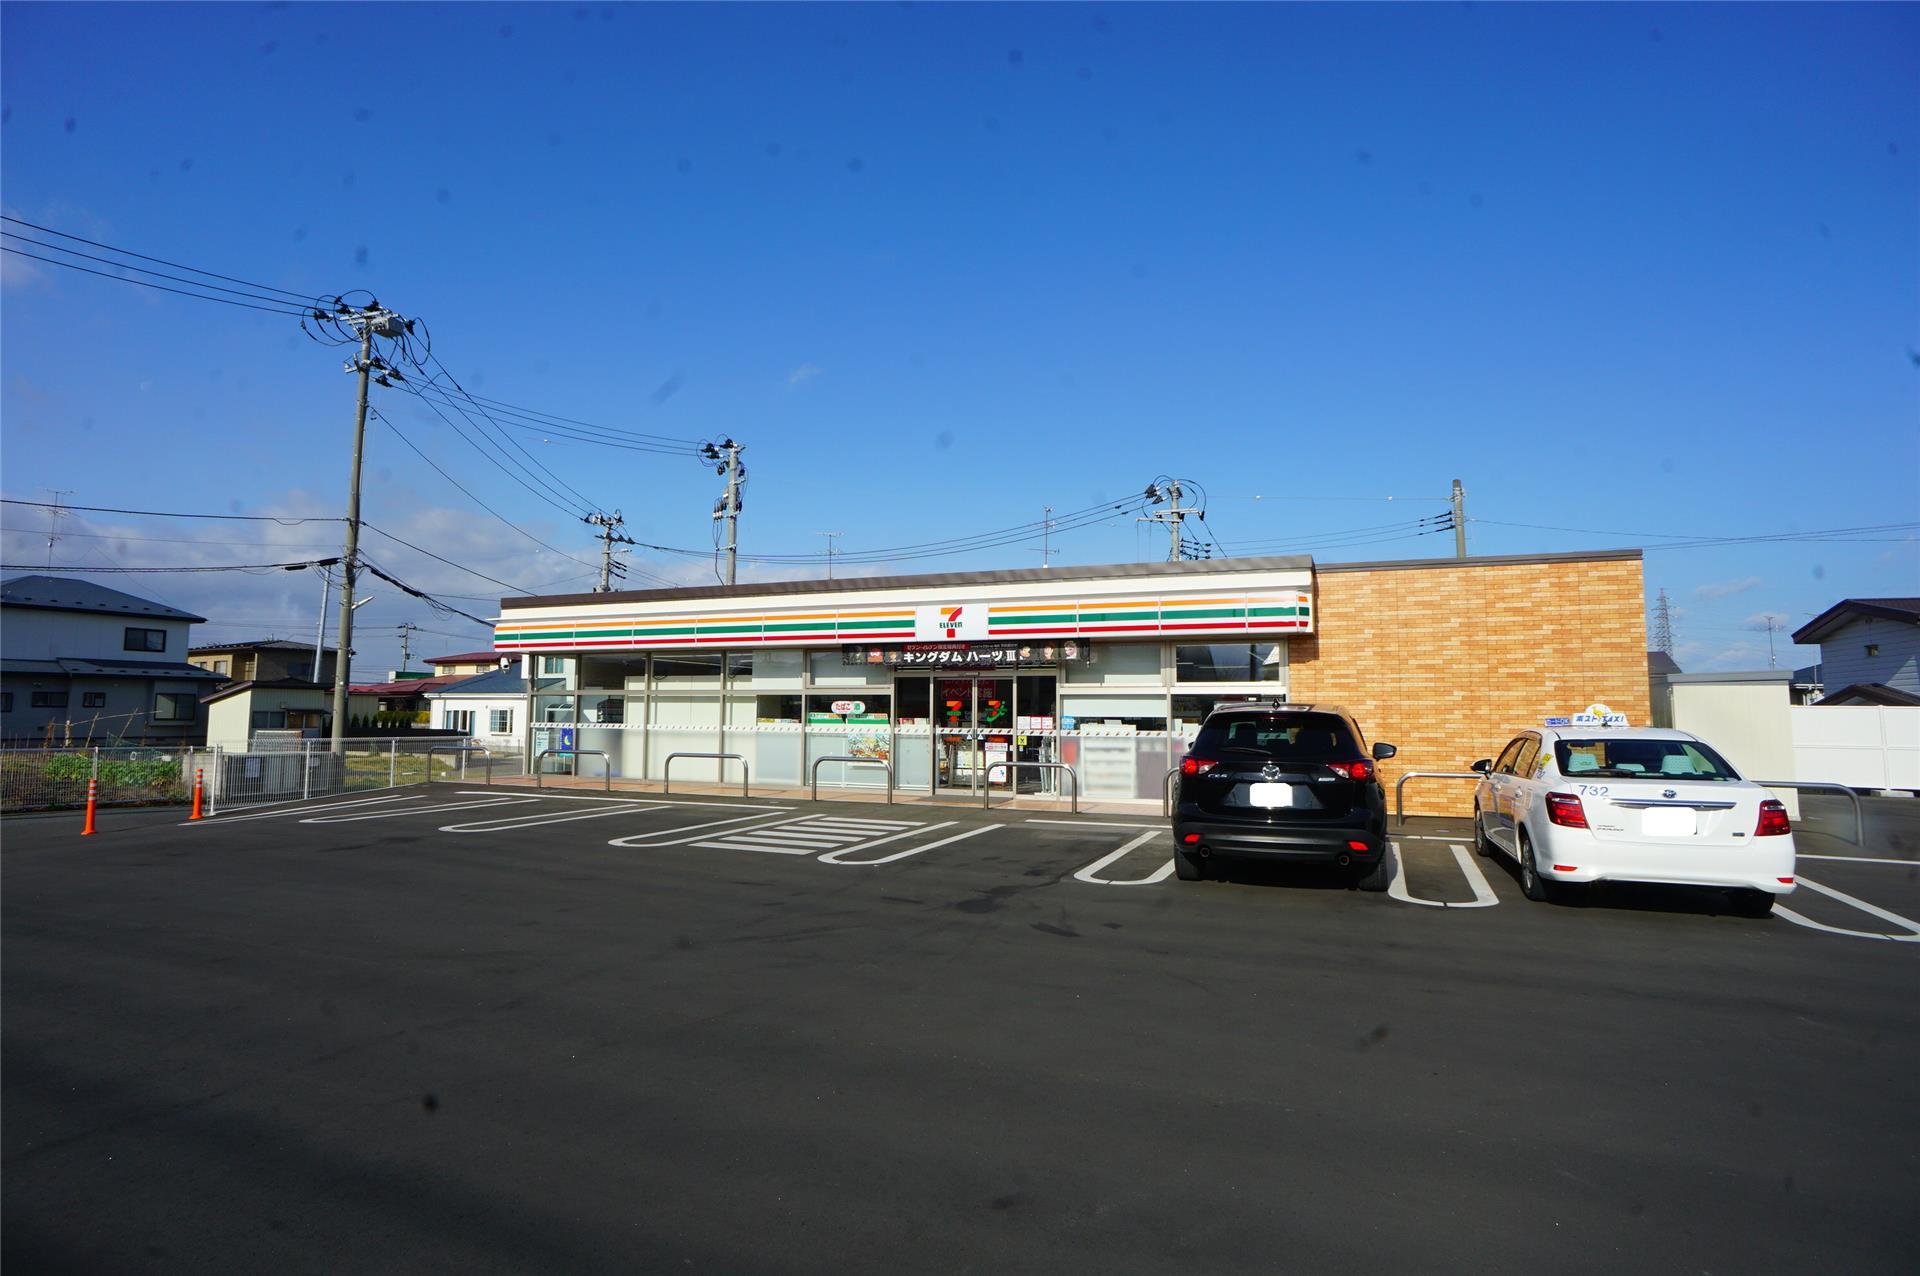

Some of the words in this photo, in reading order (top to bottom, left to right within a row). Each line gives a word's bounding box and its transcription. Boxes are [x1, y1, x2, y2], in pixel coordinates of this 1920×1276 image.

[904, 651, 962, 663] キングダム
[1578, 784, 1609, 796] 732
